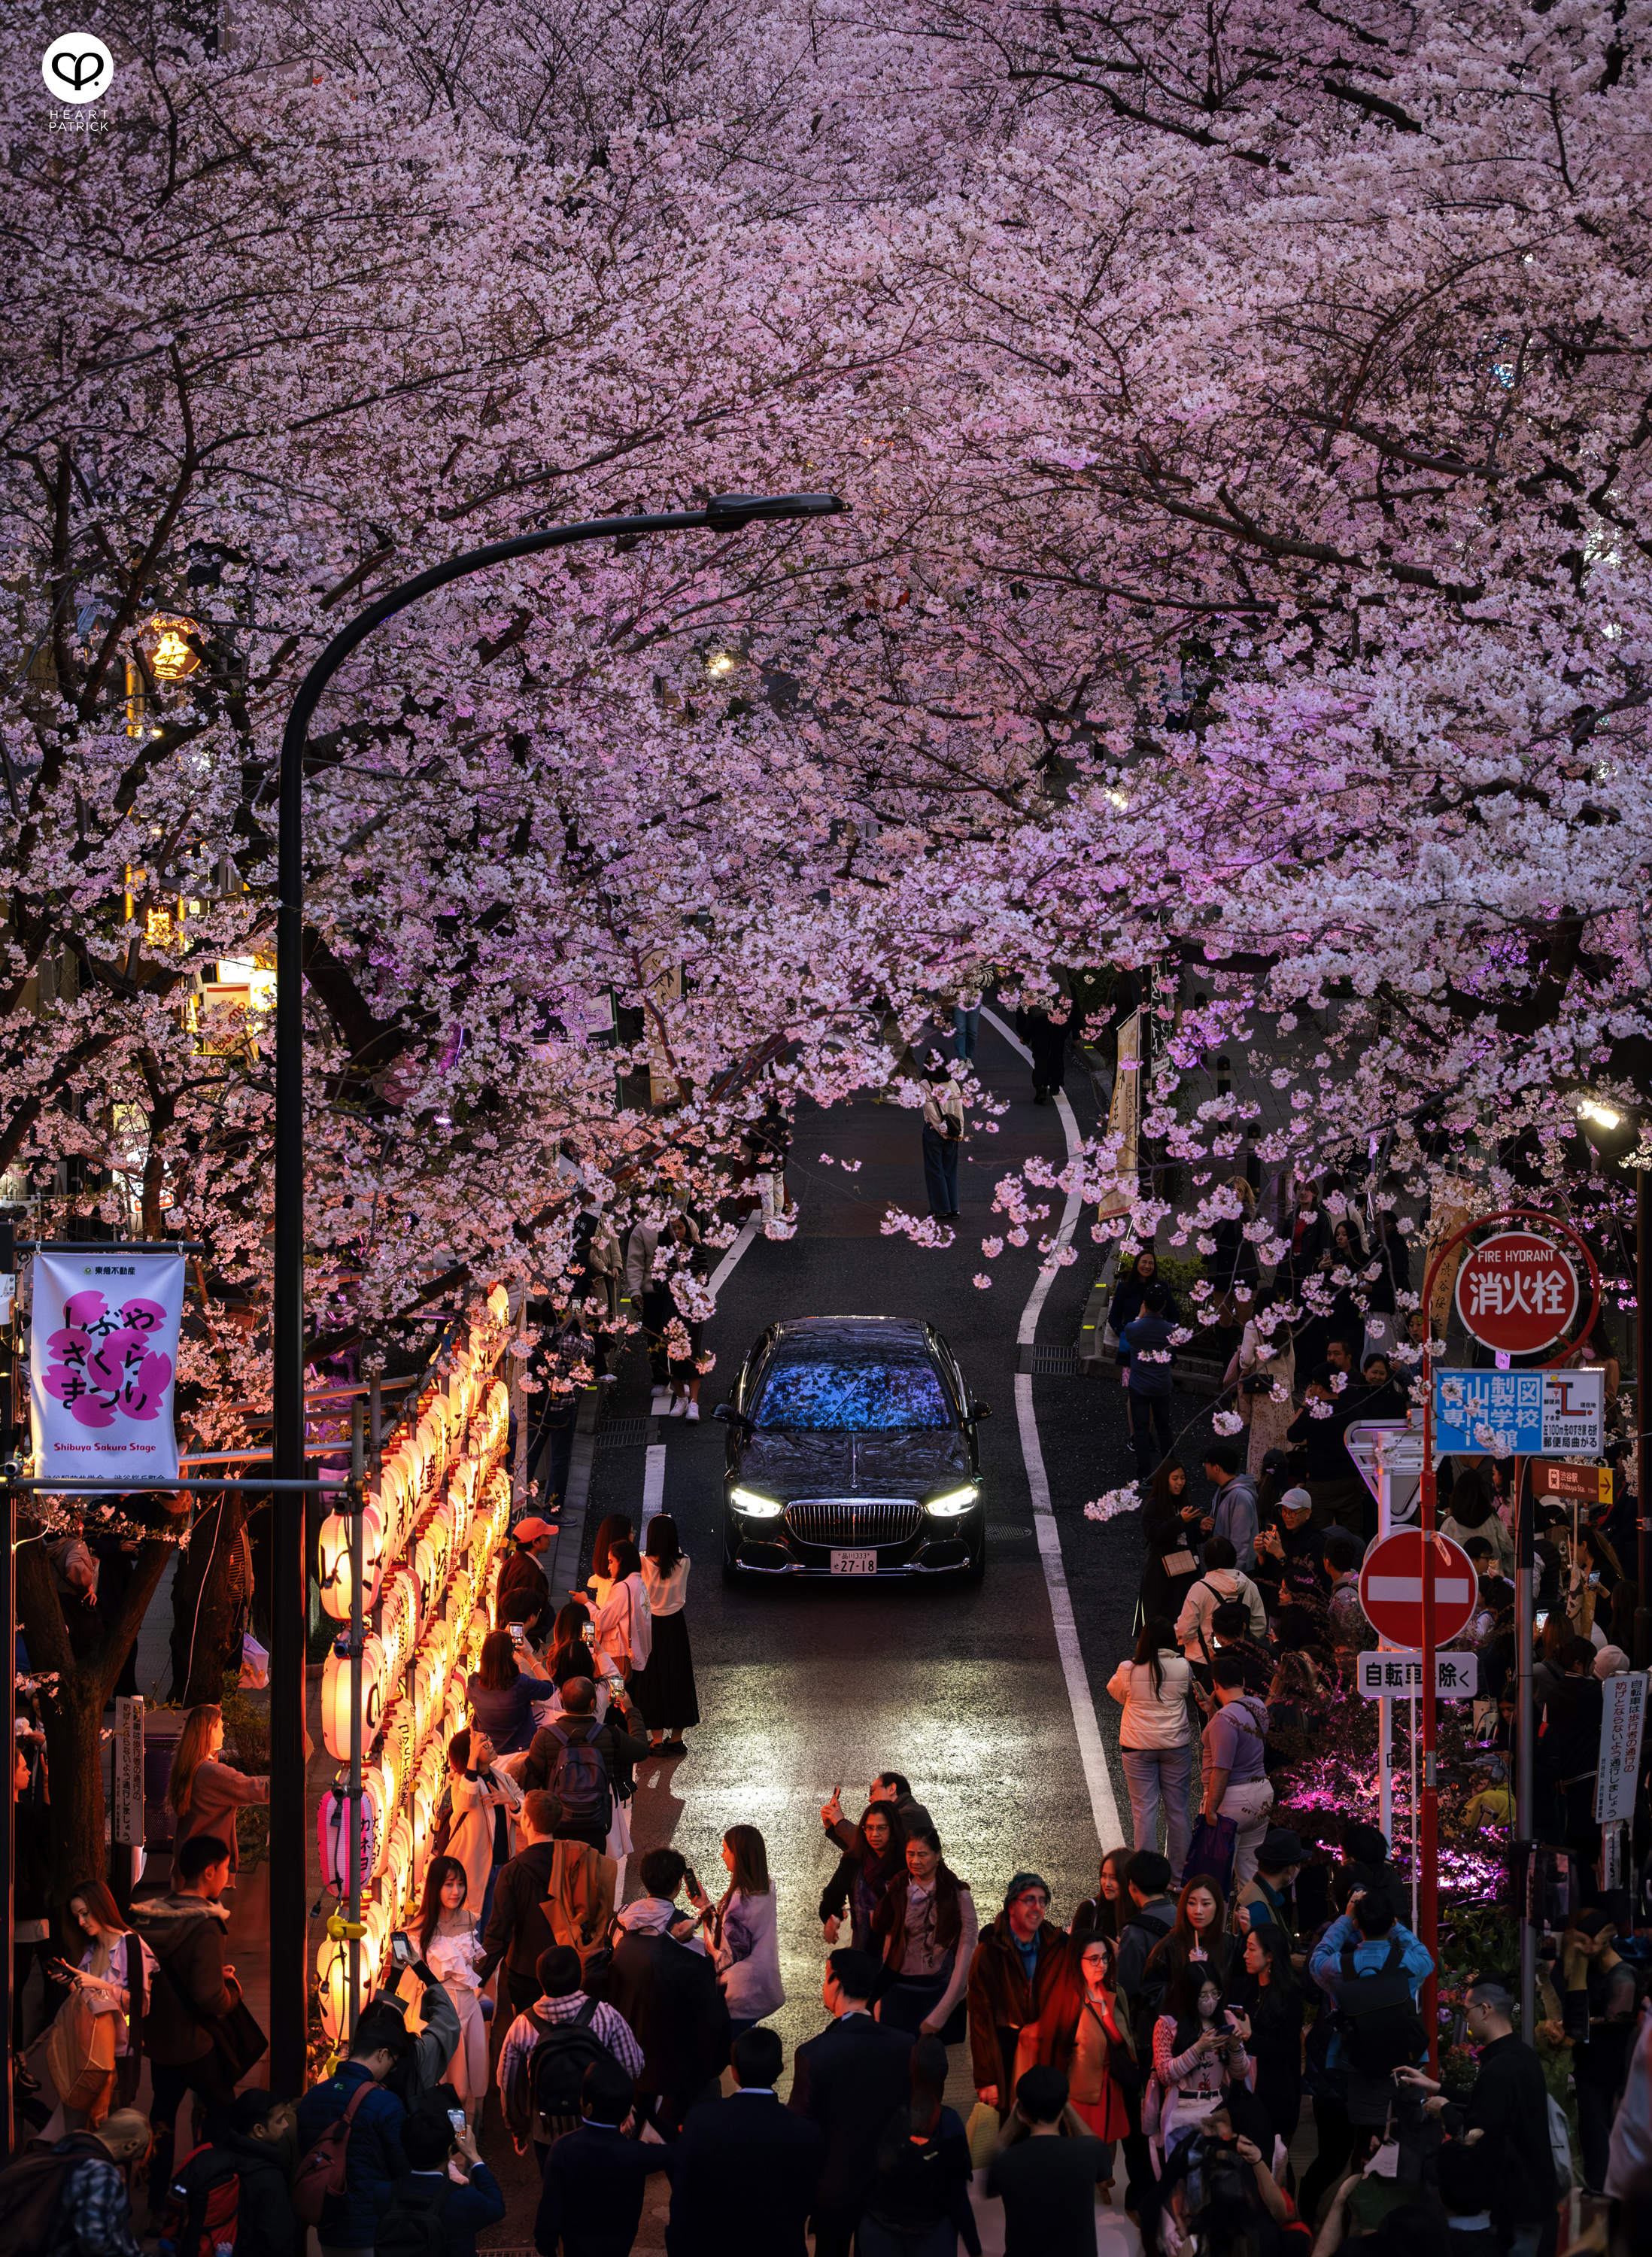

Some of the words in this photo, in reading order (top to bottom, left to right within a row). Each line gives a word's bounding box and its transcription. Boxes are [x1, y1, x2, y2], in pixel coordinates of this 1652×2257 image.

[1477, 1250, 1501, 1262] FIRE
[1505, 1249, 1554, 1262] HYDRANT
[95, 1266, 135, 1275] 東急不動産
[1469, 1269, 1567, 1316] 消火栓
[65, 1305, 155, 1338] しぶや
[62, 1341, 146, 1376] さくら
[61, 1377, 148, 1412] まつり
[1442, 1376, 1541, 1408] 青山製図
[1442, 1408, 1540, 1429] 専門学校
[54, 1442, 91, 1452] Shibuya
[94, 1442, 126, 1451] Sakura
[129, 1442, 156, 1453] Stage
[1465, 1429, 1518, 1447] 1館
[1543, 1436, 1597, 1448] 郵便局曲がる
[1559, 1471, 1578, 1484] 渋谷駅
[1559, 1482, 1578, 1493] Shibuya
[841, 1560, 874, 1572] 27-18
[1365, 1661, 1470, 1688] 自転車除く
[1623, 1679, 1643, 1773] 自転車は歩行者の通行の
[1606, 1681, 1627, 1818] 妨げとならないよう通行しましょう
